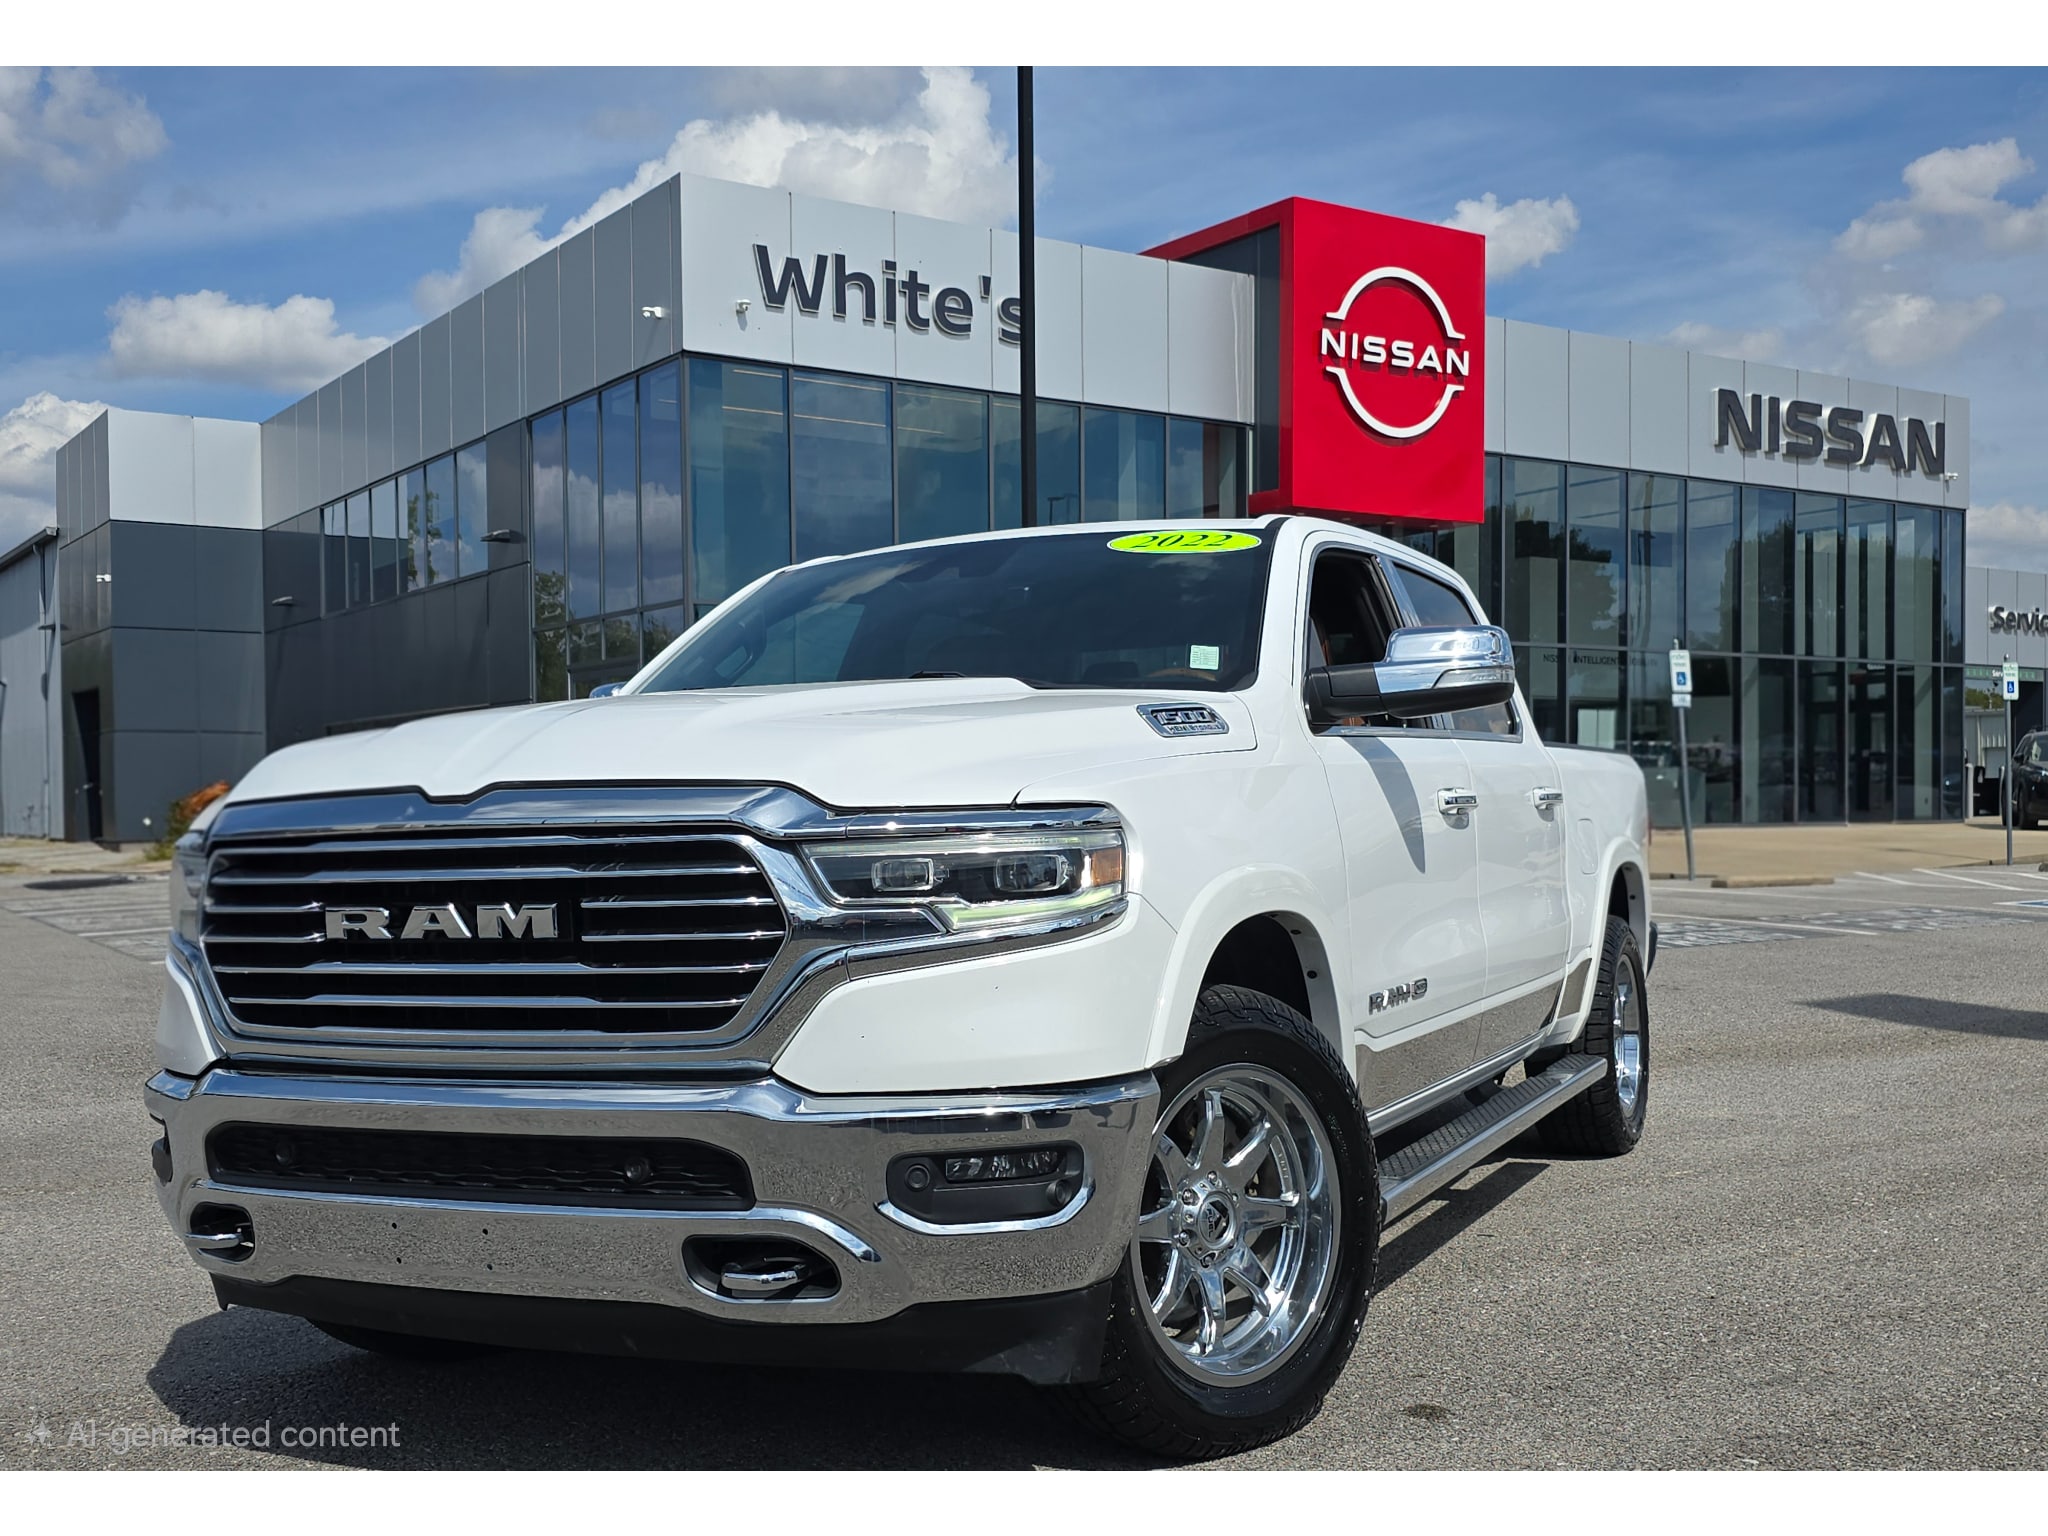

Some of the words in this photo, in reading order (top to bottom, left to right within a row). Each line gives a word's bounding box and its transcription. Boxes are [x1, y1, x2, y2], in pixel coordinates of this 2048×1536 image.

[753, 243, 1022, 345] White's
[1320, 327, 1470, 377] NISSAN
[1713, 386, 1946, 476] NISSAN
[1131, 534, 1233, 549] 2022
[1154, 710, 1214, 725] 1500
[325, 902, 560, 940] RAM
